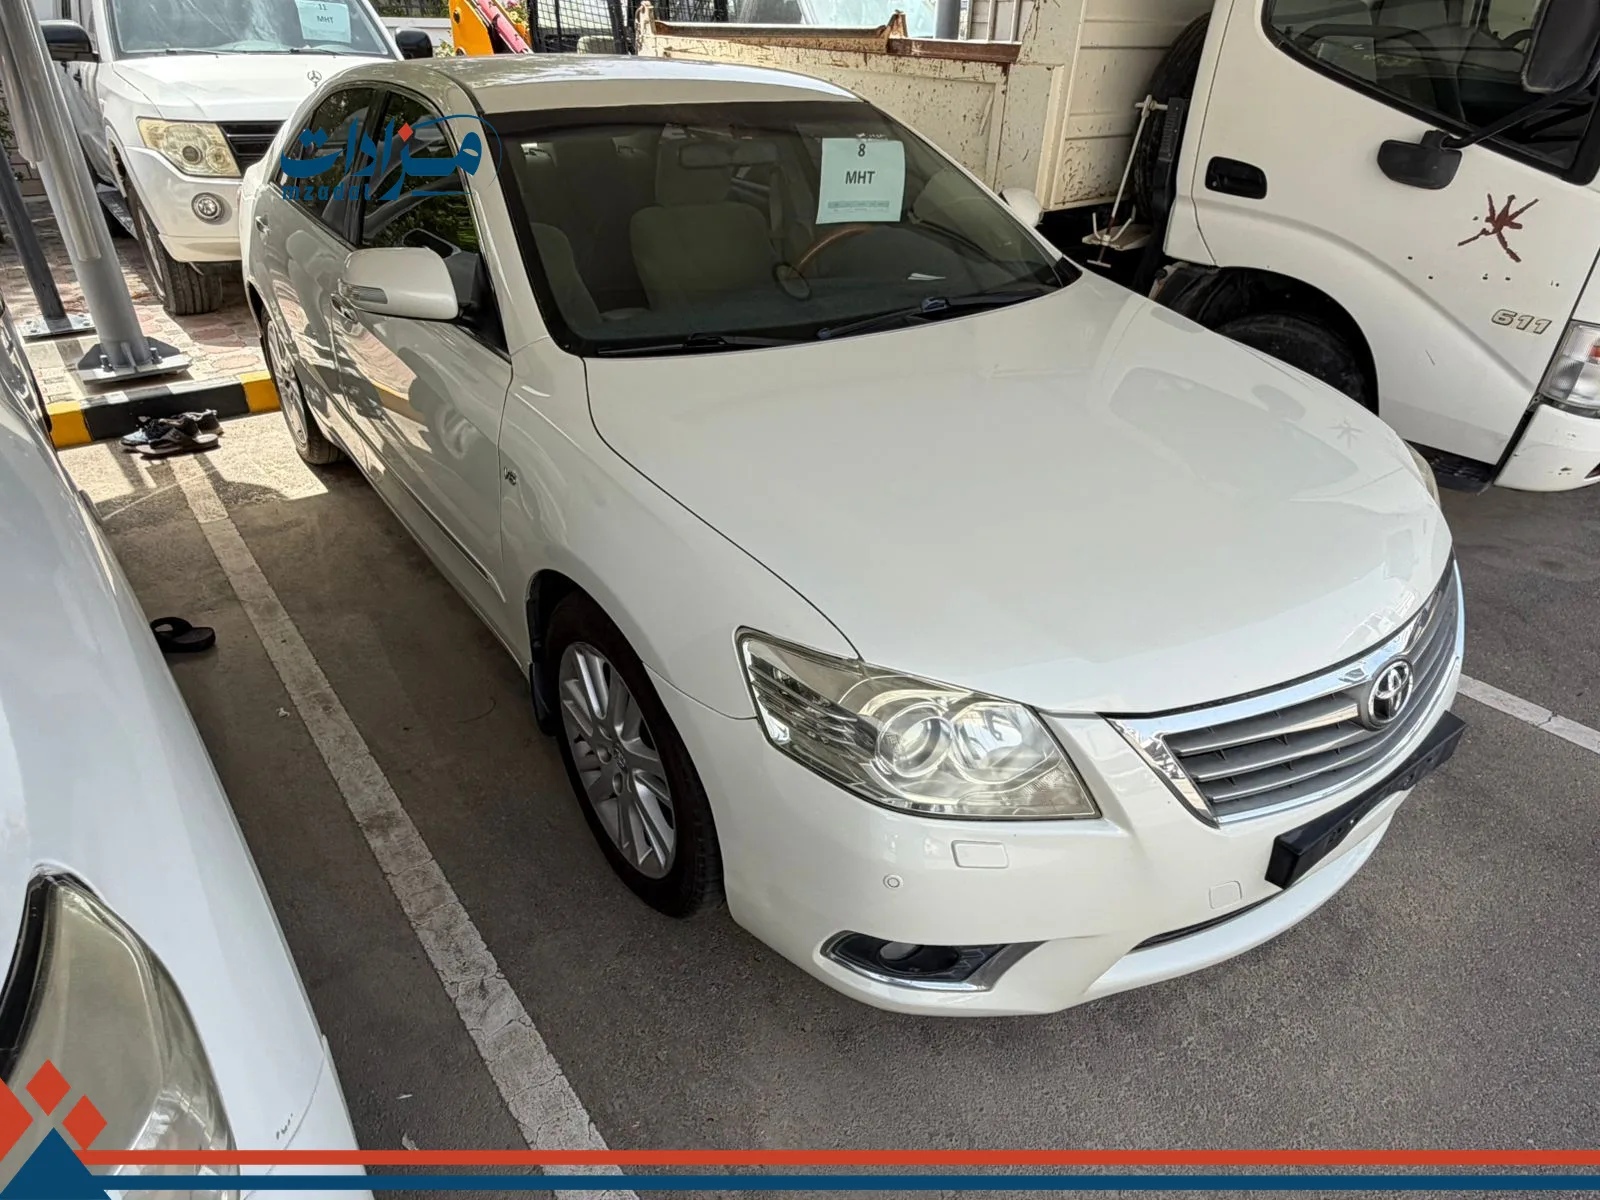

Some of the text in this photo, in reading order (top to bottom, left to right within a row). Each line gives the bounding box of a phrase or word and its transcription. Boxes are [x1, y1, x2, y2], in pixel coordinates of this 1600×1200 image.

[857, 143, 867, 158] 8
[845, 170, 876, 185] MHT
[1491, 308, 1553, 335] 611
